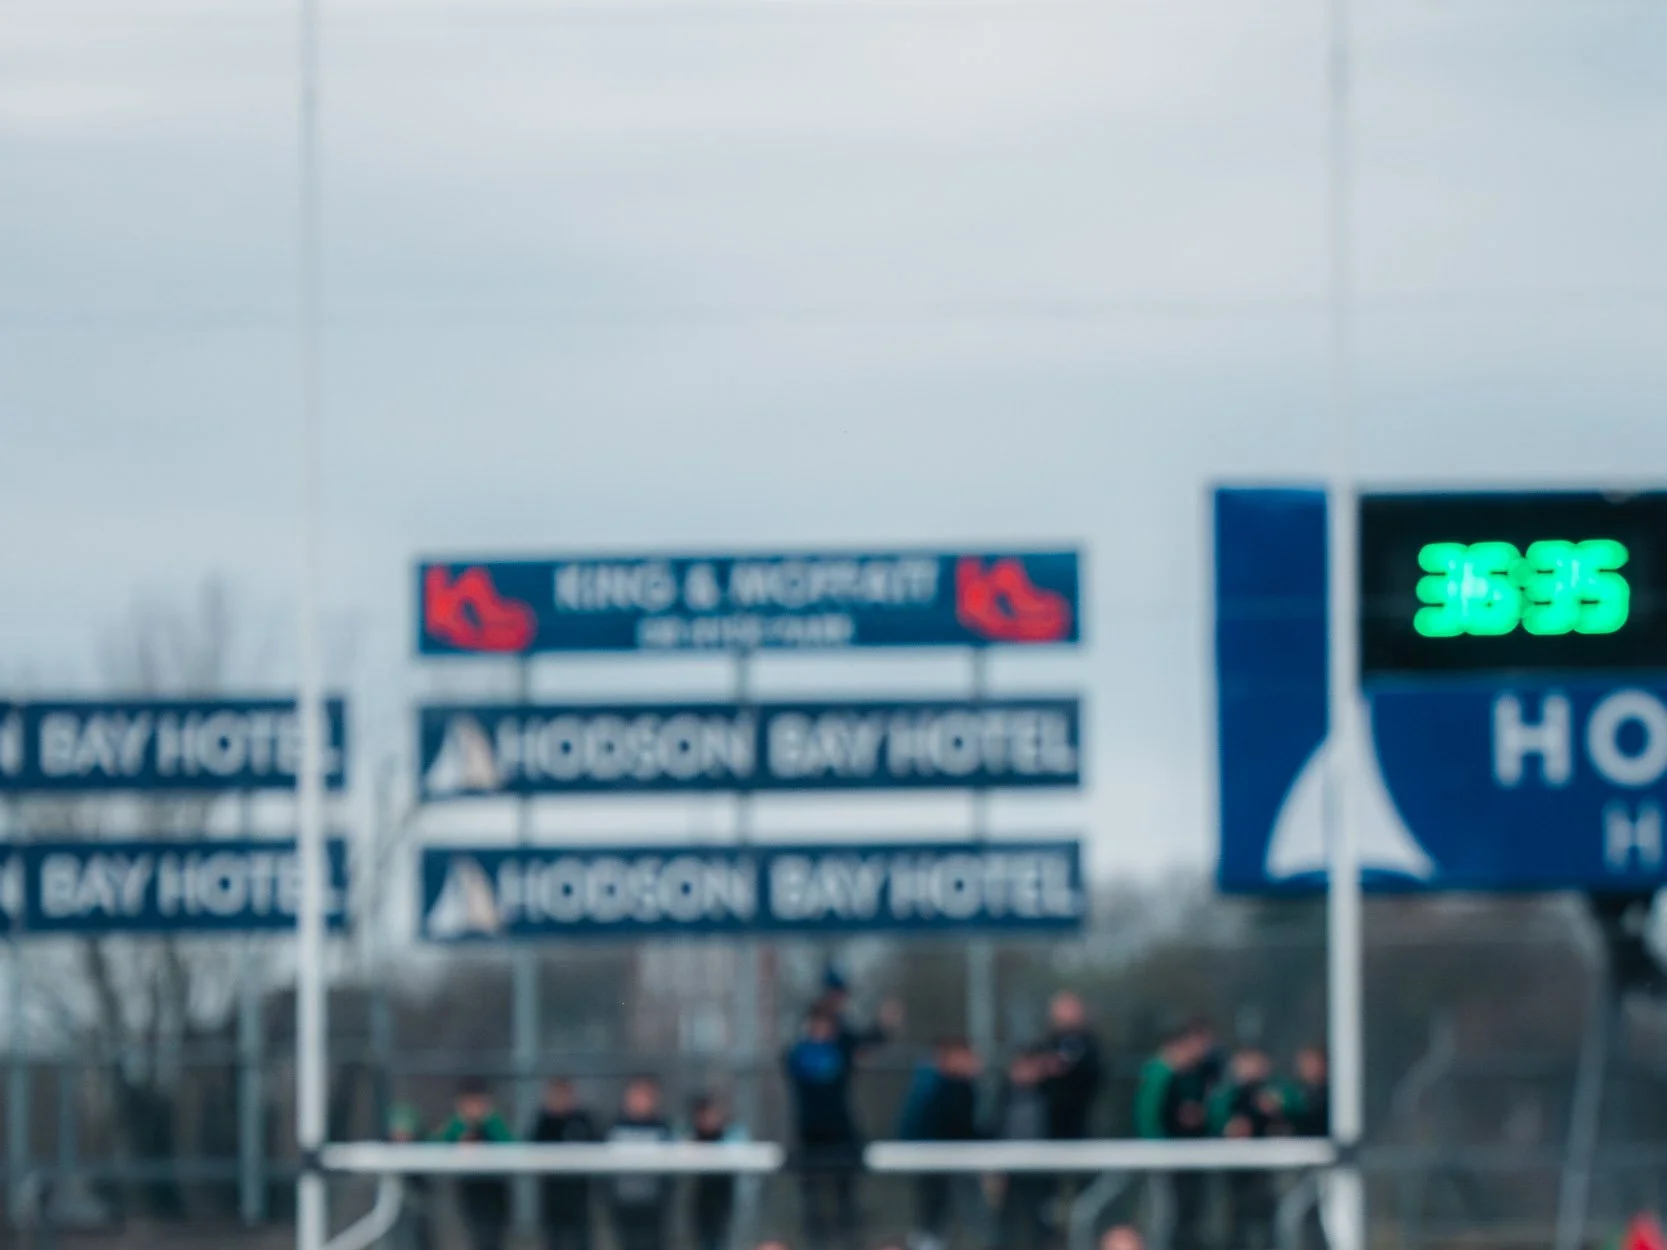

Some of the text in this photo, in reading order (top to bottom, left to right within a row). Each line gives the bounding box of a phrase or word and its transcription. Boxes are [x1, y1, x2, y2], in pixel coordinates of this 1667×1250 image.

[39, 711, 151, 777] BAY
[497, 709, 1078, 780] HODSON BAY HOTEL
[1493, 690, 1667, 787] HO
[40, 852, 152, 917] BAY
[498, 851, 1080, 922] HODSON BAY HOTEL
